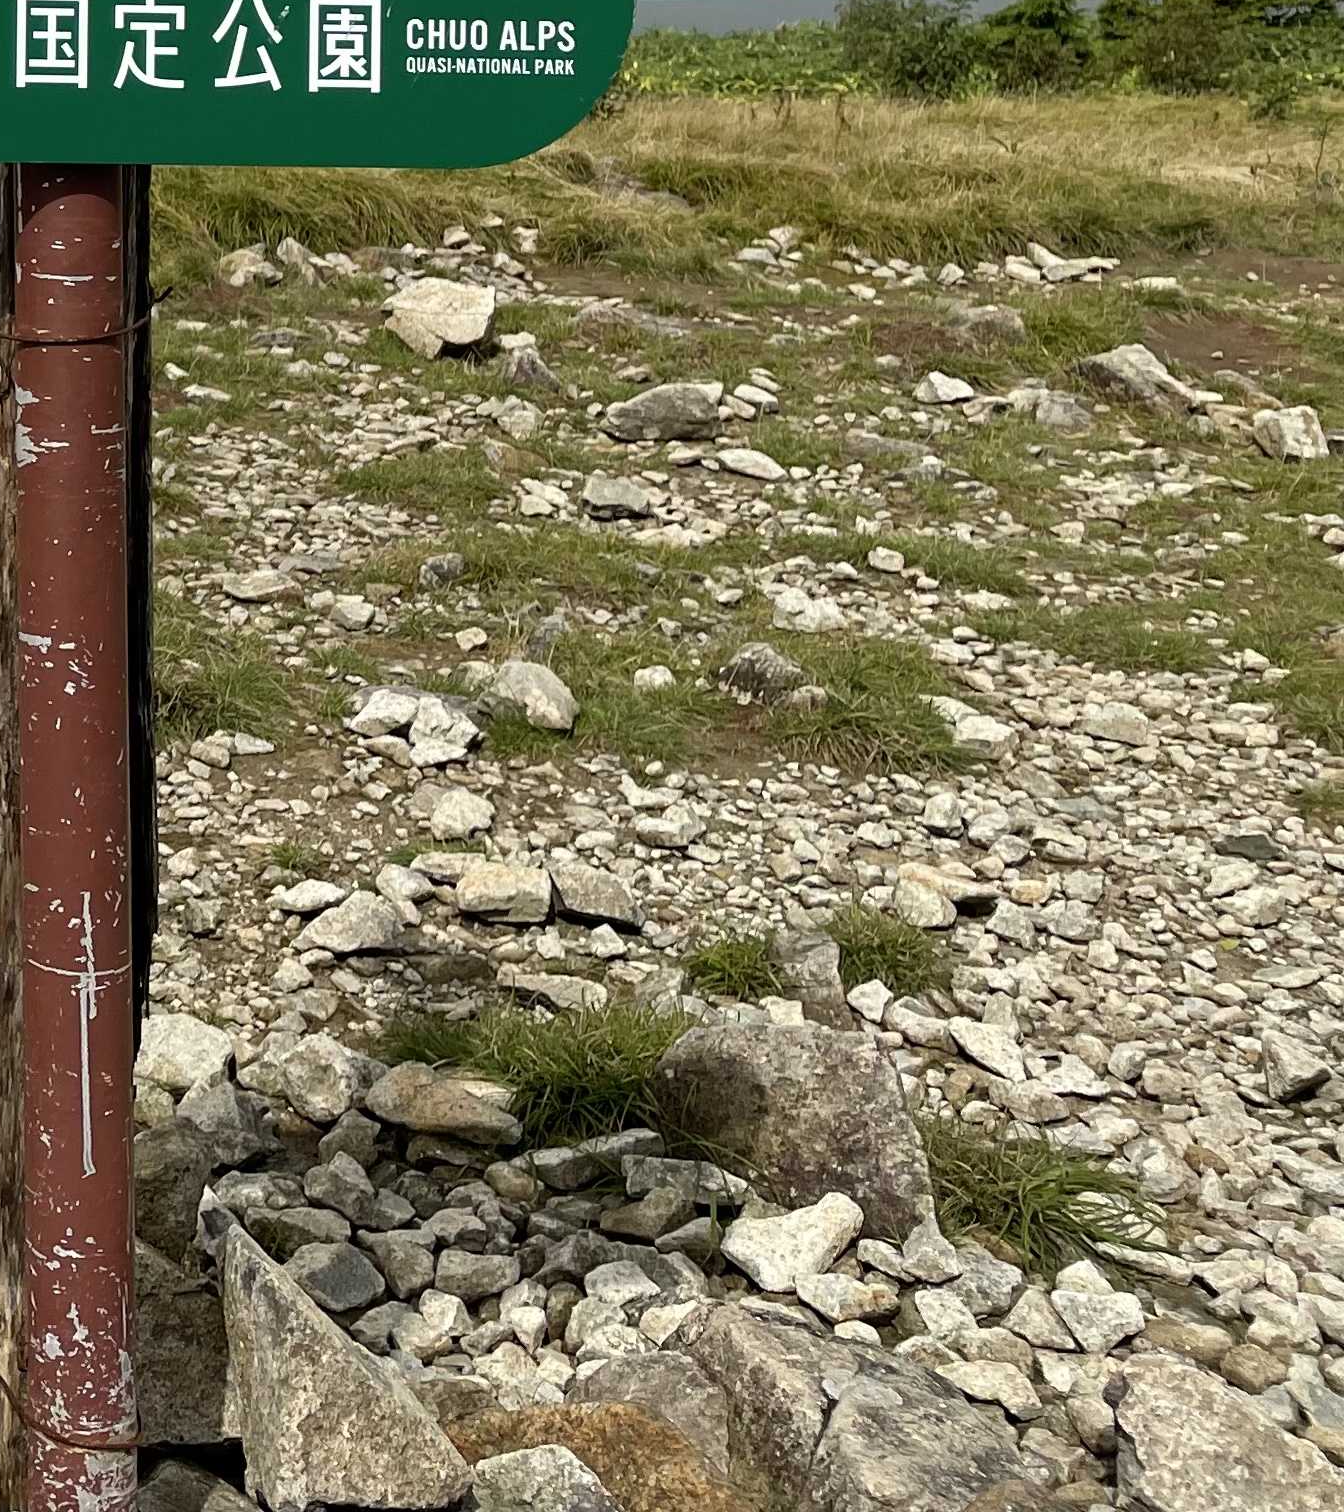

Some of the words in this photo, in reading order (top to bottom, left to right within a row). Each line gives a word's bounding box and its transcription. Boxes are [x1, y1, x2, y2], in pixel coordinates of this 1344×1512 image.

[407, 19, 487, 50] CHUO
[500, 21, 574, 51] ALPS
[407, 57, 530, 74] QUASI-NATIONAL
[535, 59, 574, 74] PARK
